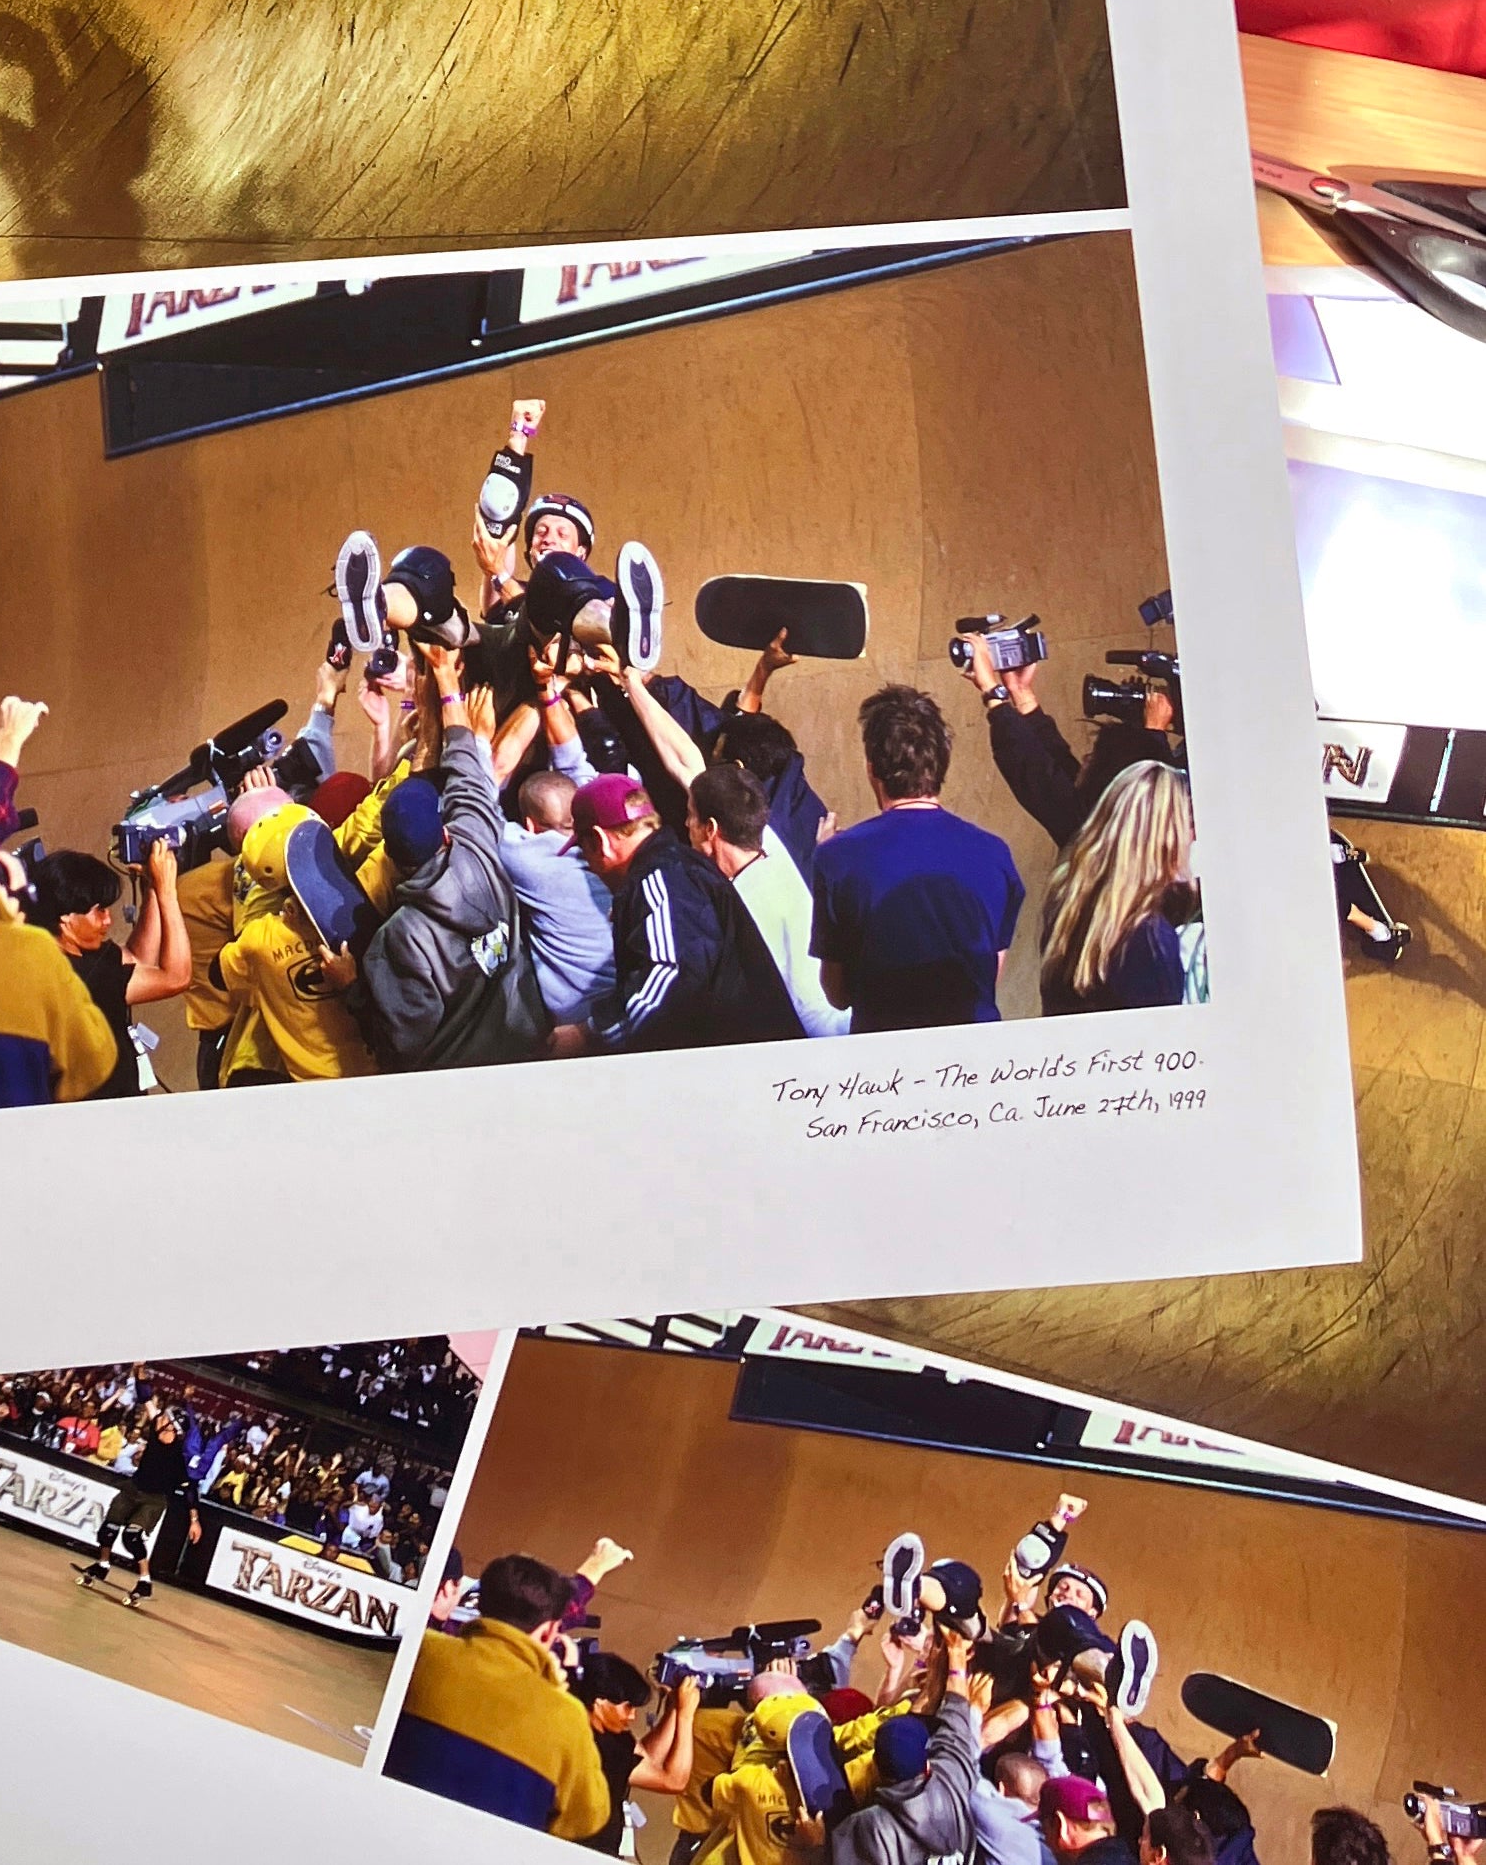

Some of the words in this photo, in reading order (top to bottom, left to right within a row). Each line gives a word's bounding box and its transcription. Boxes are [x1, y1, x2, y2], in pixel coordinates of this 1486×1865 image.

[772, 1078, 829, 1108] Tony
[839, 1068, 904, 1099] Hawk
[935, 1063, 978, 1088] The
[990, 1053, 1077, 1084] World's
[1088, 1049, 1144, 1075] First
[806, 1116, 848, 1139] San
[857, 1109, 979, 1135] Francisco,
[989, 1102, 1024, 1123] Ca.
[1033, 1095, 1087, 1118] June
[1097, 1088, 1160, 1116] 27th,
[1169, 1089, 1206, 1110] 1999
[232, 1540, 401, 1636] TARZAN
